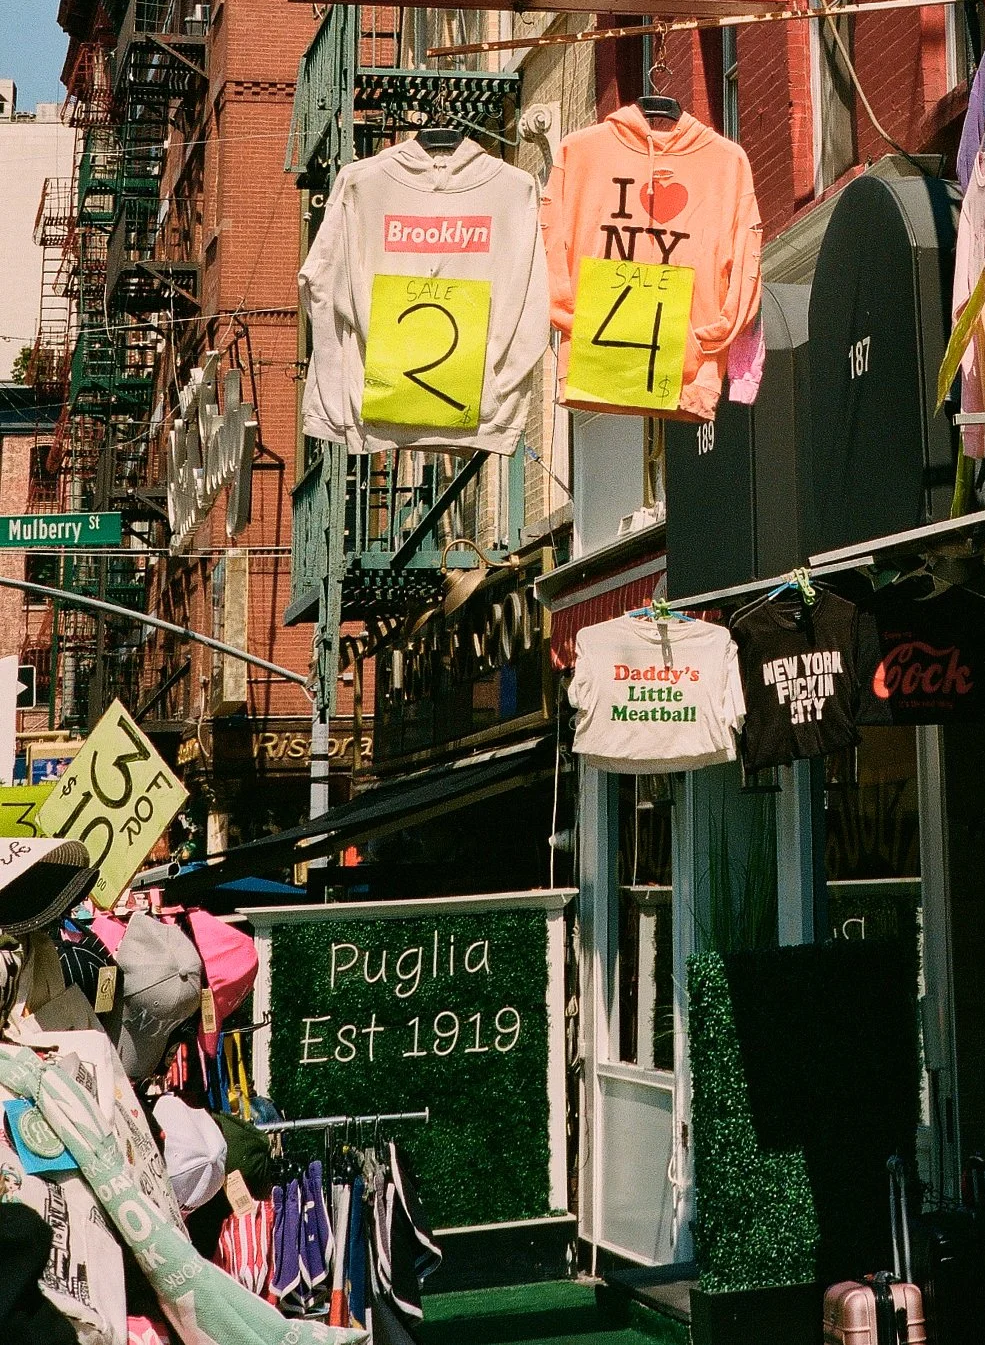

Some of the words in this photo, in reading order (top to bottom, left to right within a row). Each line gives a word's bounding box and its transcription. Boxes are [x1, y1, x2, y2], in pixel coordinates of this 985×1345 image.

[611, 176, 635, 220] I
[387, 219, 488, 249] Brooklyn
[600, 224, 690, 264] NY
[406, 279, 460, 303] SALE
[609, 263, 671, 291] SALE
[591, 285, 663, 393] 4
[397, 302, 468, 411] 2
[848, 336, 872, 380] 187
[696, 422, 715, 456] 189
[9, 518, 82, 544] Mulberry
[88, 515, 100, 530] St
[613, 664, 700, 684] Daddy's
[762, 656, 799, 686] NEW
[801, 650, 844, 676] YORK
[872, 640, 975, 700] Cock
[627, 685, 684, 703] Little
[777, 673, 835, 705] FUCKIN
[610, 705, 698, 724] Meatball
[790, 696, 826, 725] CITY
[253, 732, 374, 759] Risora
[119, 770, 173, 847] FOR
[331, 929, 492, 998] Puglia
[299, 1013, 385, 1065] Est
[403, 1006, 521, 1057] 1919
